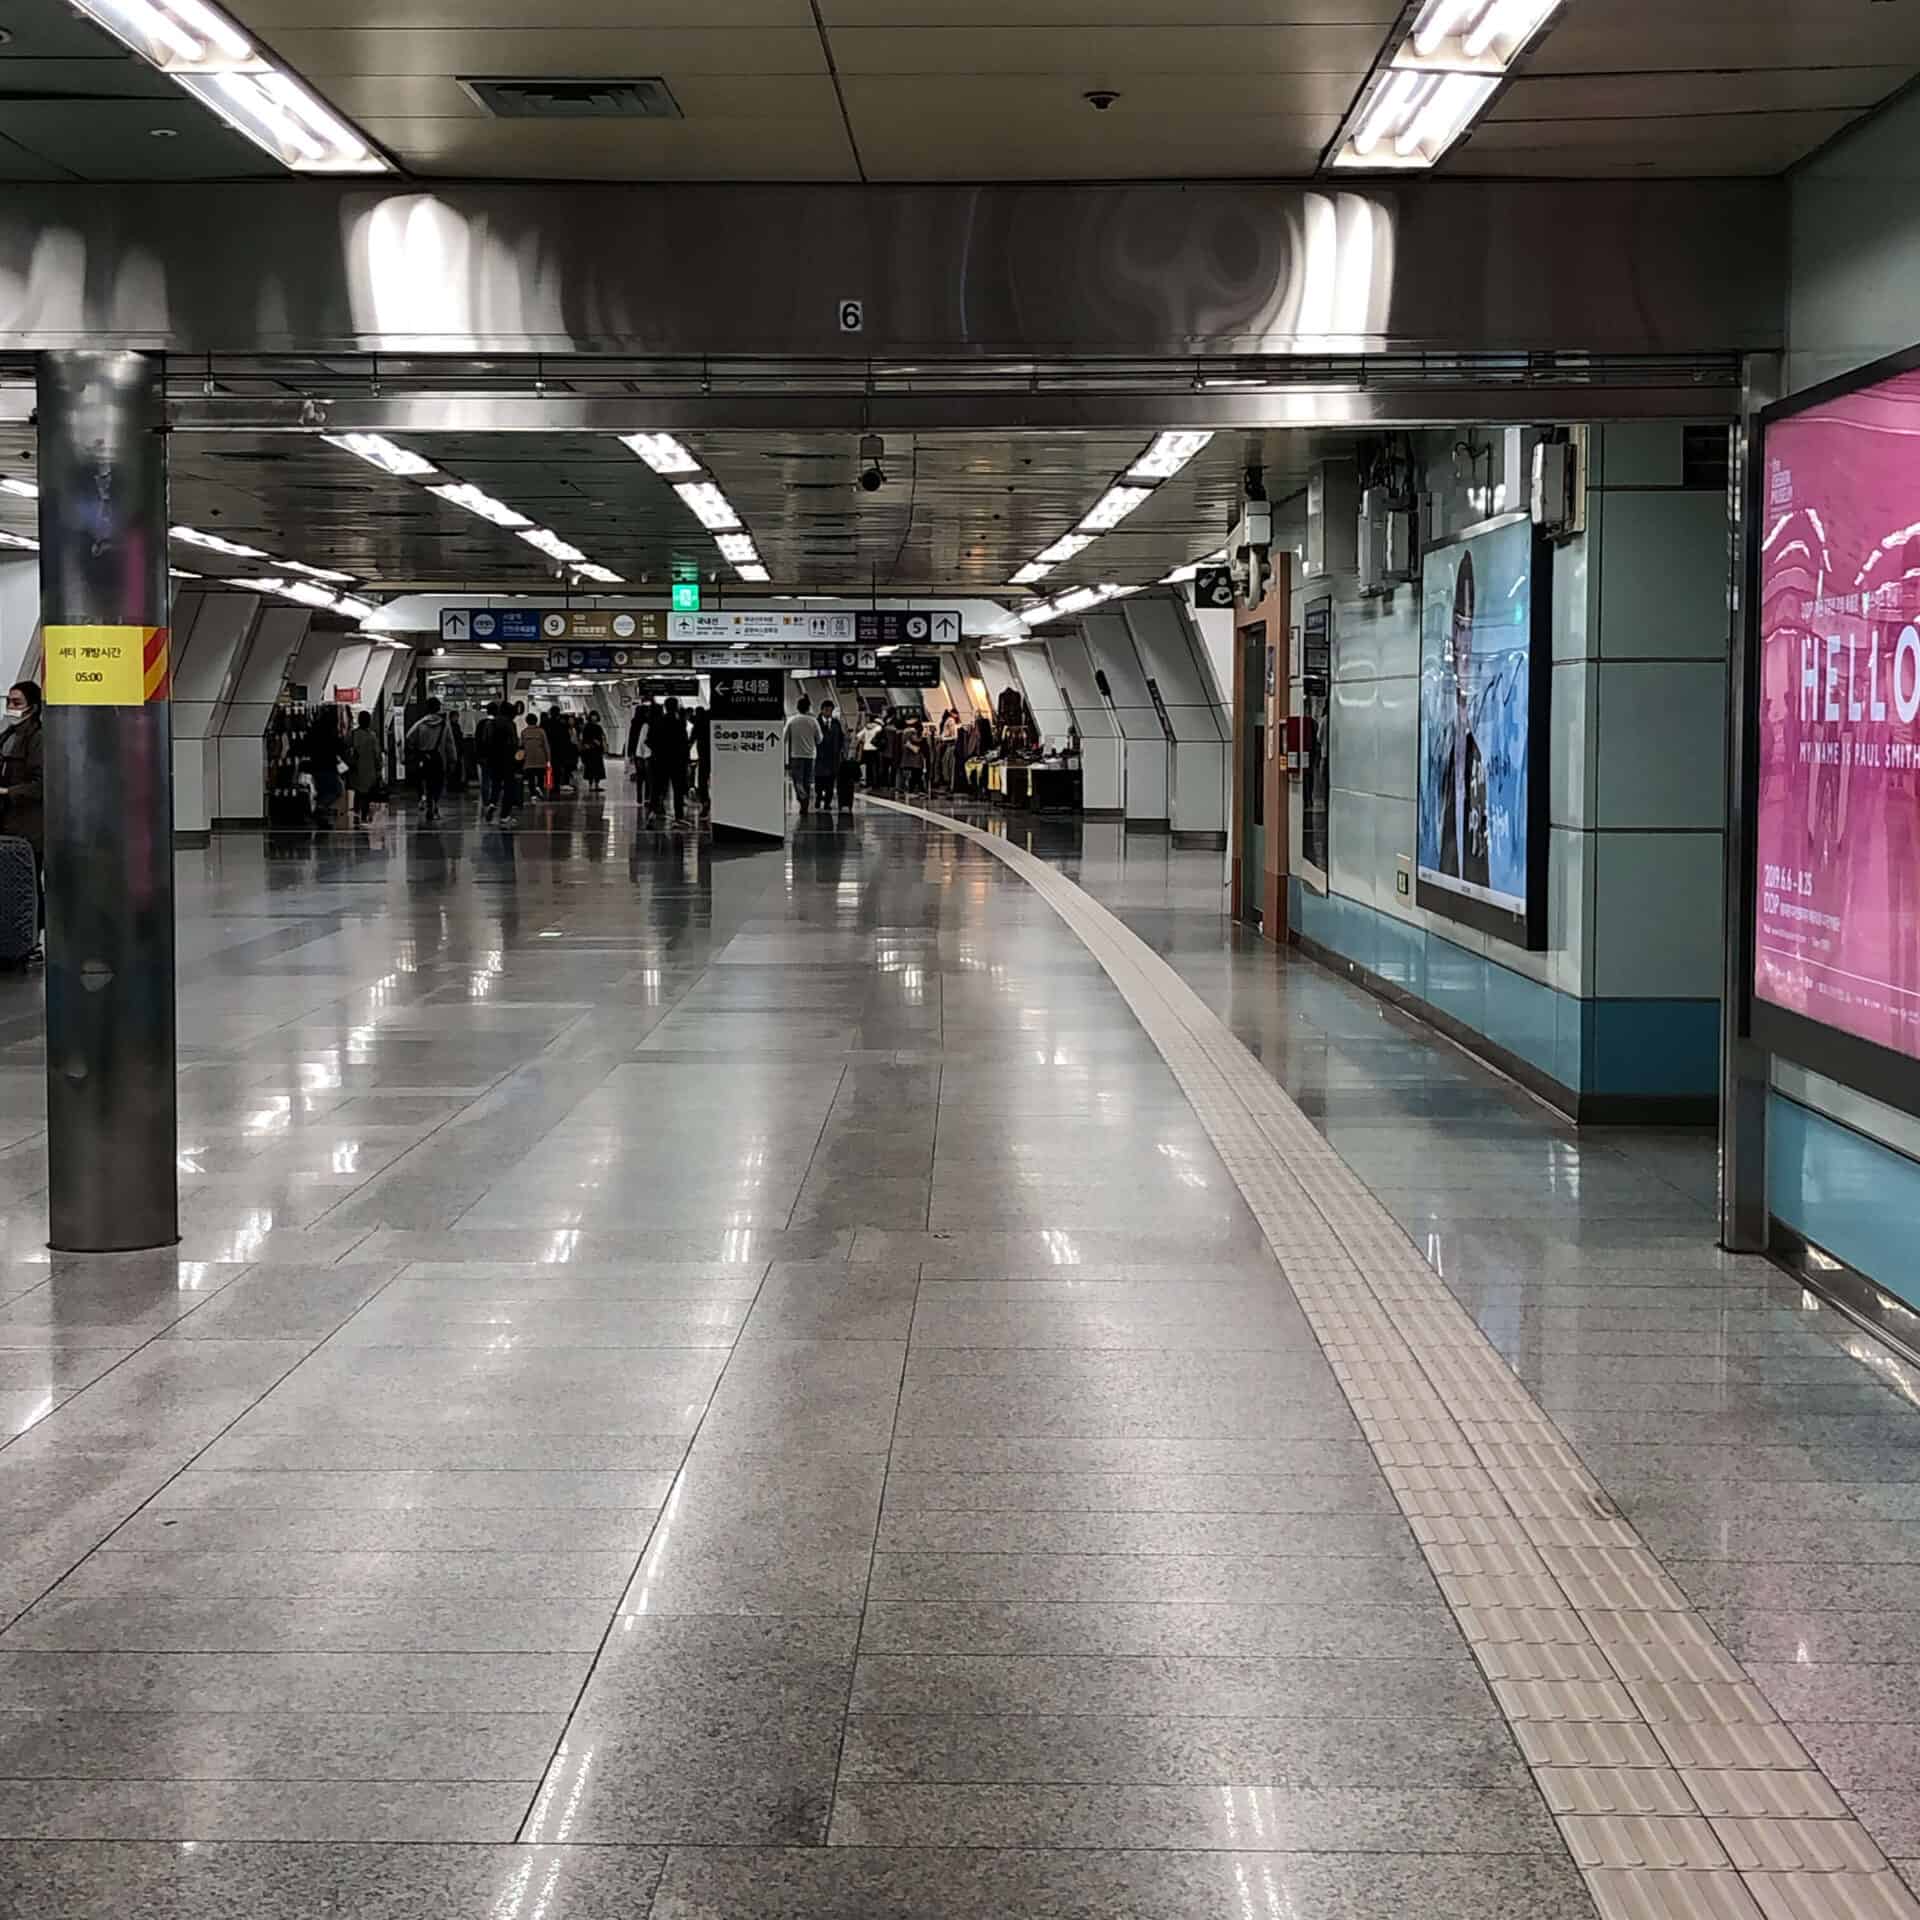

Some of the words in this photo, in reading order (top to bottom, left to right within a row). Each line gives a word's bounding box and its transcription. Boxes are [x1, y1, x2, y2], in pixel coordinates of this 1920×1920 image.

[842, 303, 859, 329] 6
[550, 619, 558, 631] 9
[912, 620, 922, 635] 5
[75, 672, 103, 682] 05:00
[1801, 625, 1920, 724] HELLO
[1800, 742, 1814, 763] MY
[1815, 742, 1839, 765] NAME
[1855, 743, 1880, 767] PAUL
[1885, 744, 1920, 769] SMITH
